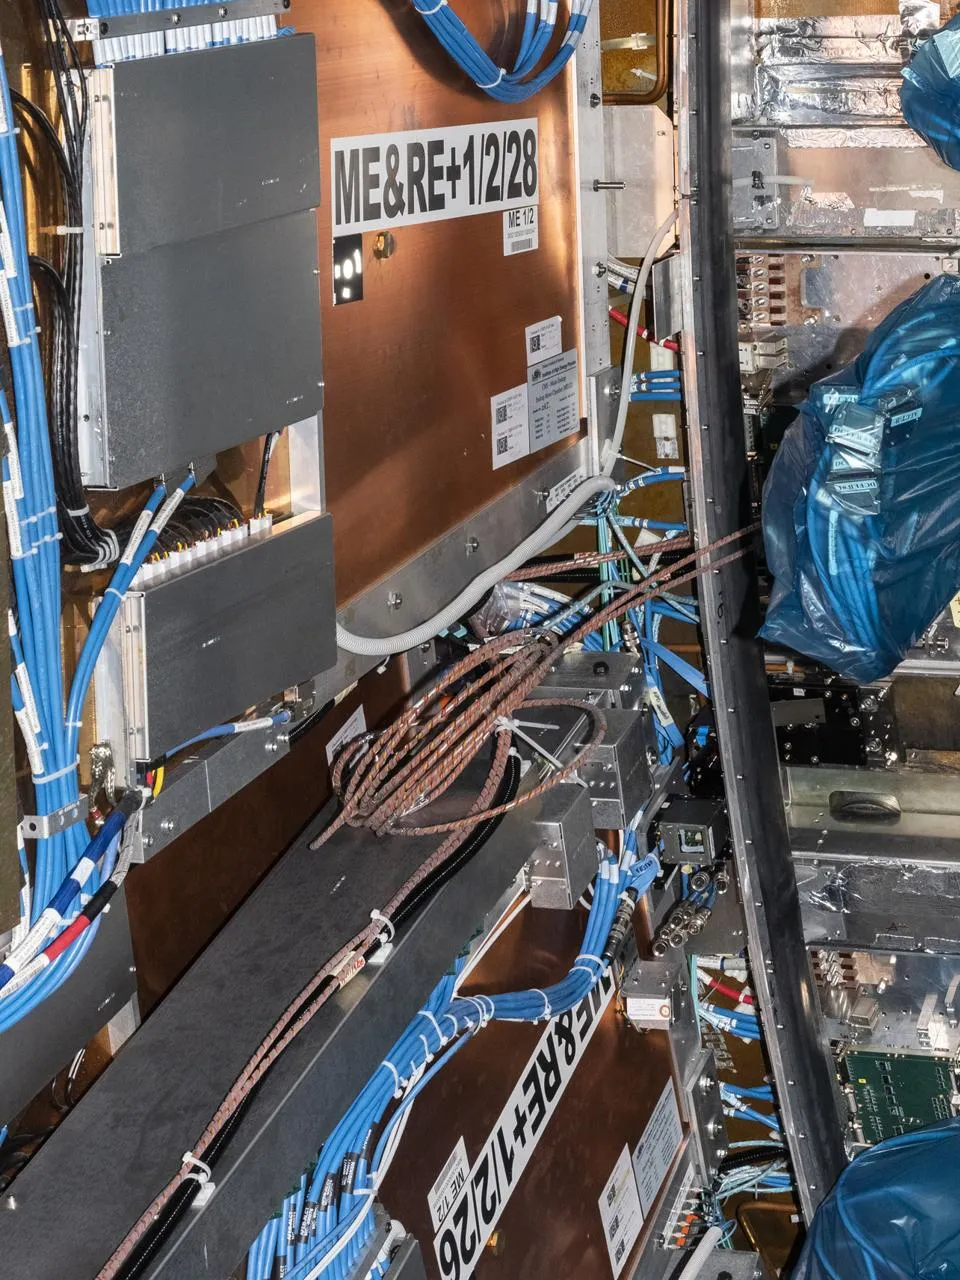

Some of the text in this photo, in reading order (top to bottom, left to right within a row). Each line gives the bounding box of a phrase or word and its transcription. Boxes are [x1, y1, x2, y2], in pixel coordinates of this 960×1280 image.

[334, 128, 538, 226] ME&RE+1/2/28
[508, 207, 534, 228] ME 1/2
[450, 1167, 465, 1200] ME
[436, 1195, 450, 1223] 1/2
